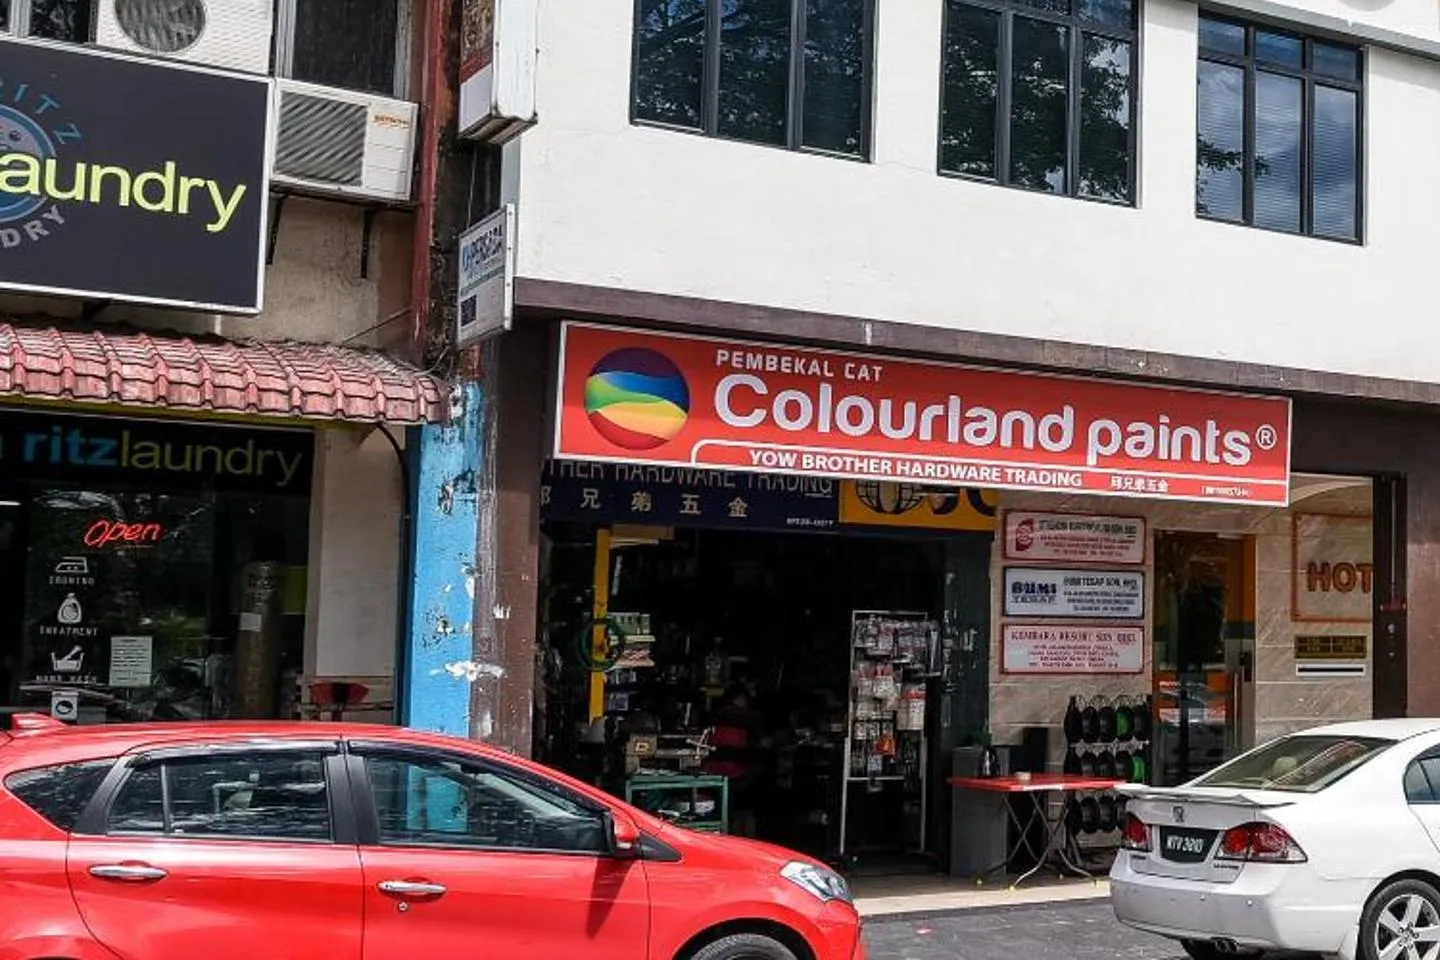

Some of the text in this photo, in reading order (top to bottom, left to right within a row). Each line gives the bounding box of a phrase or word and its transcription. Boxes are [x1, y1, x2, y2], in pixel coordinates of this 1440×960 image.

[716, 349, 883, 382] PEMBEKAL CAT
[714, 373, 1075, 453] Colourland
[750, 450, 1083, 488] YOW BROTHER HARDWARE TRADING
[83, 518, 161, 548] Open
